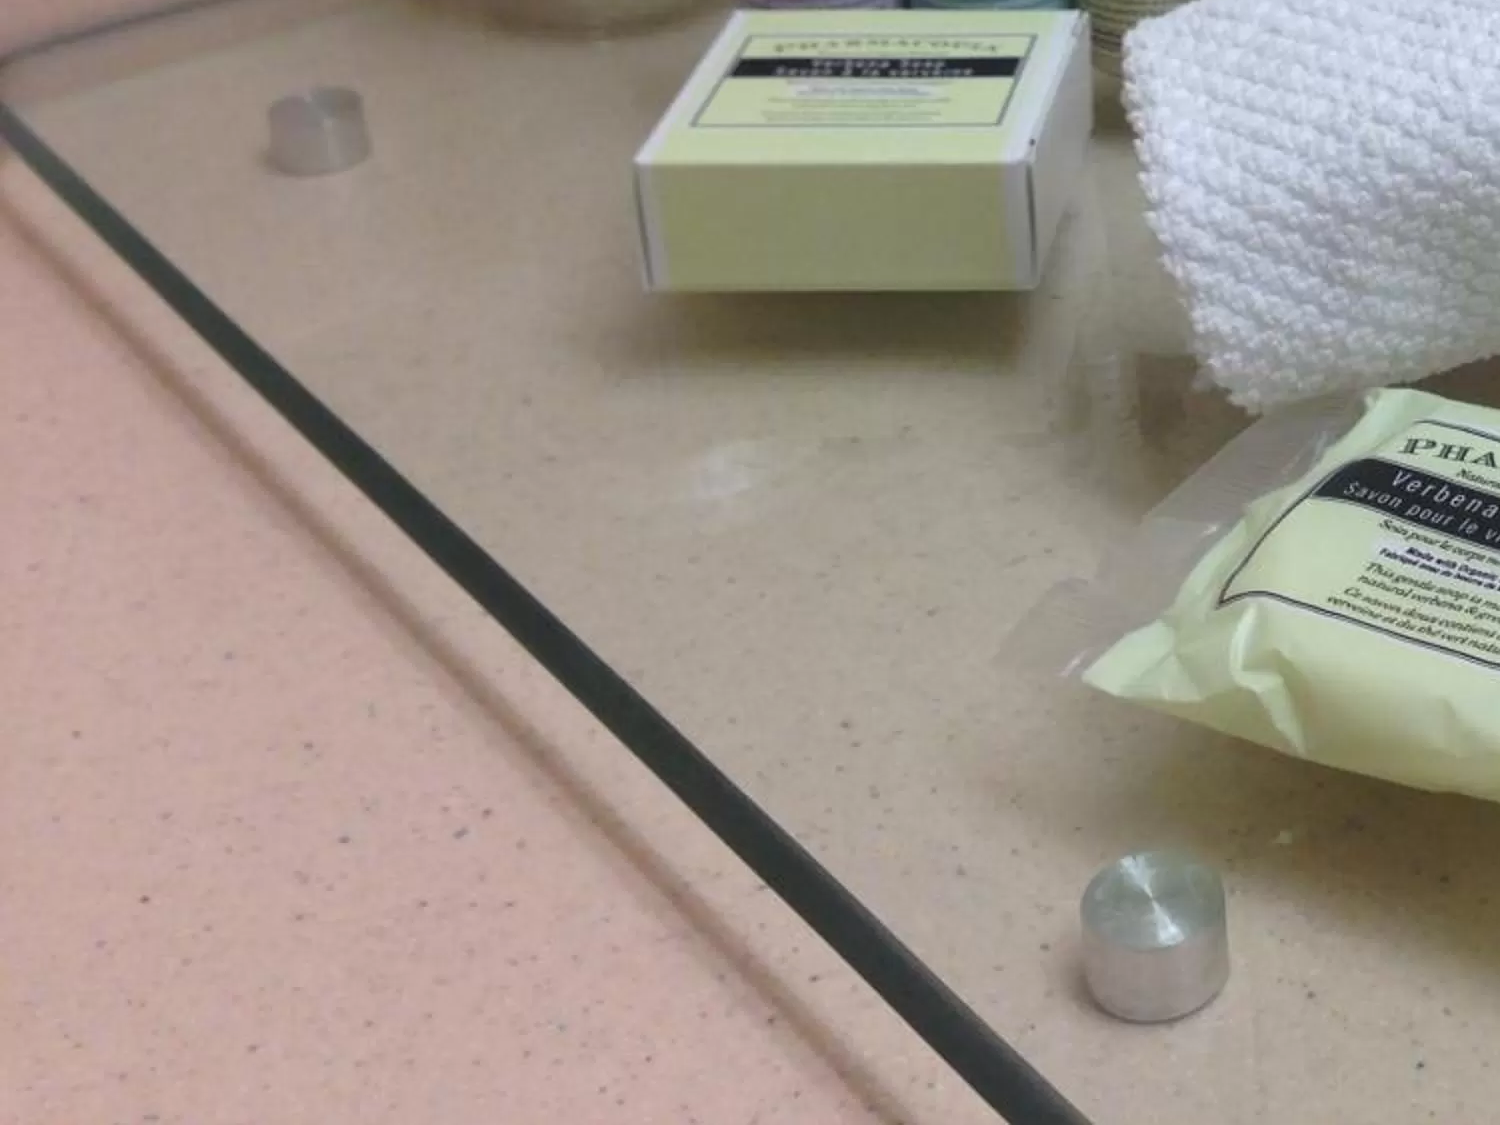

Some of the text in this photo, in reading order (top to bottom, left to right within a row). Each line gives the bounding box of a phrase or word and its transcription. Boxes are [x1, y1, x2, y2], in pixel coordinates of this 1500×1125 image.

[1343, 480, 1403, 508] Savon
[1404, 503, 1455, 526] pour
[1457, 518, 1479, 535] le
[1392, 469, 1500, 519] Verbena
